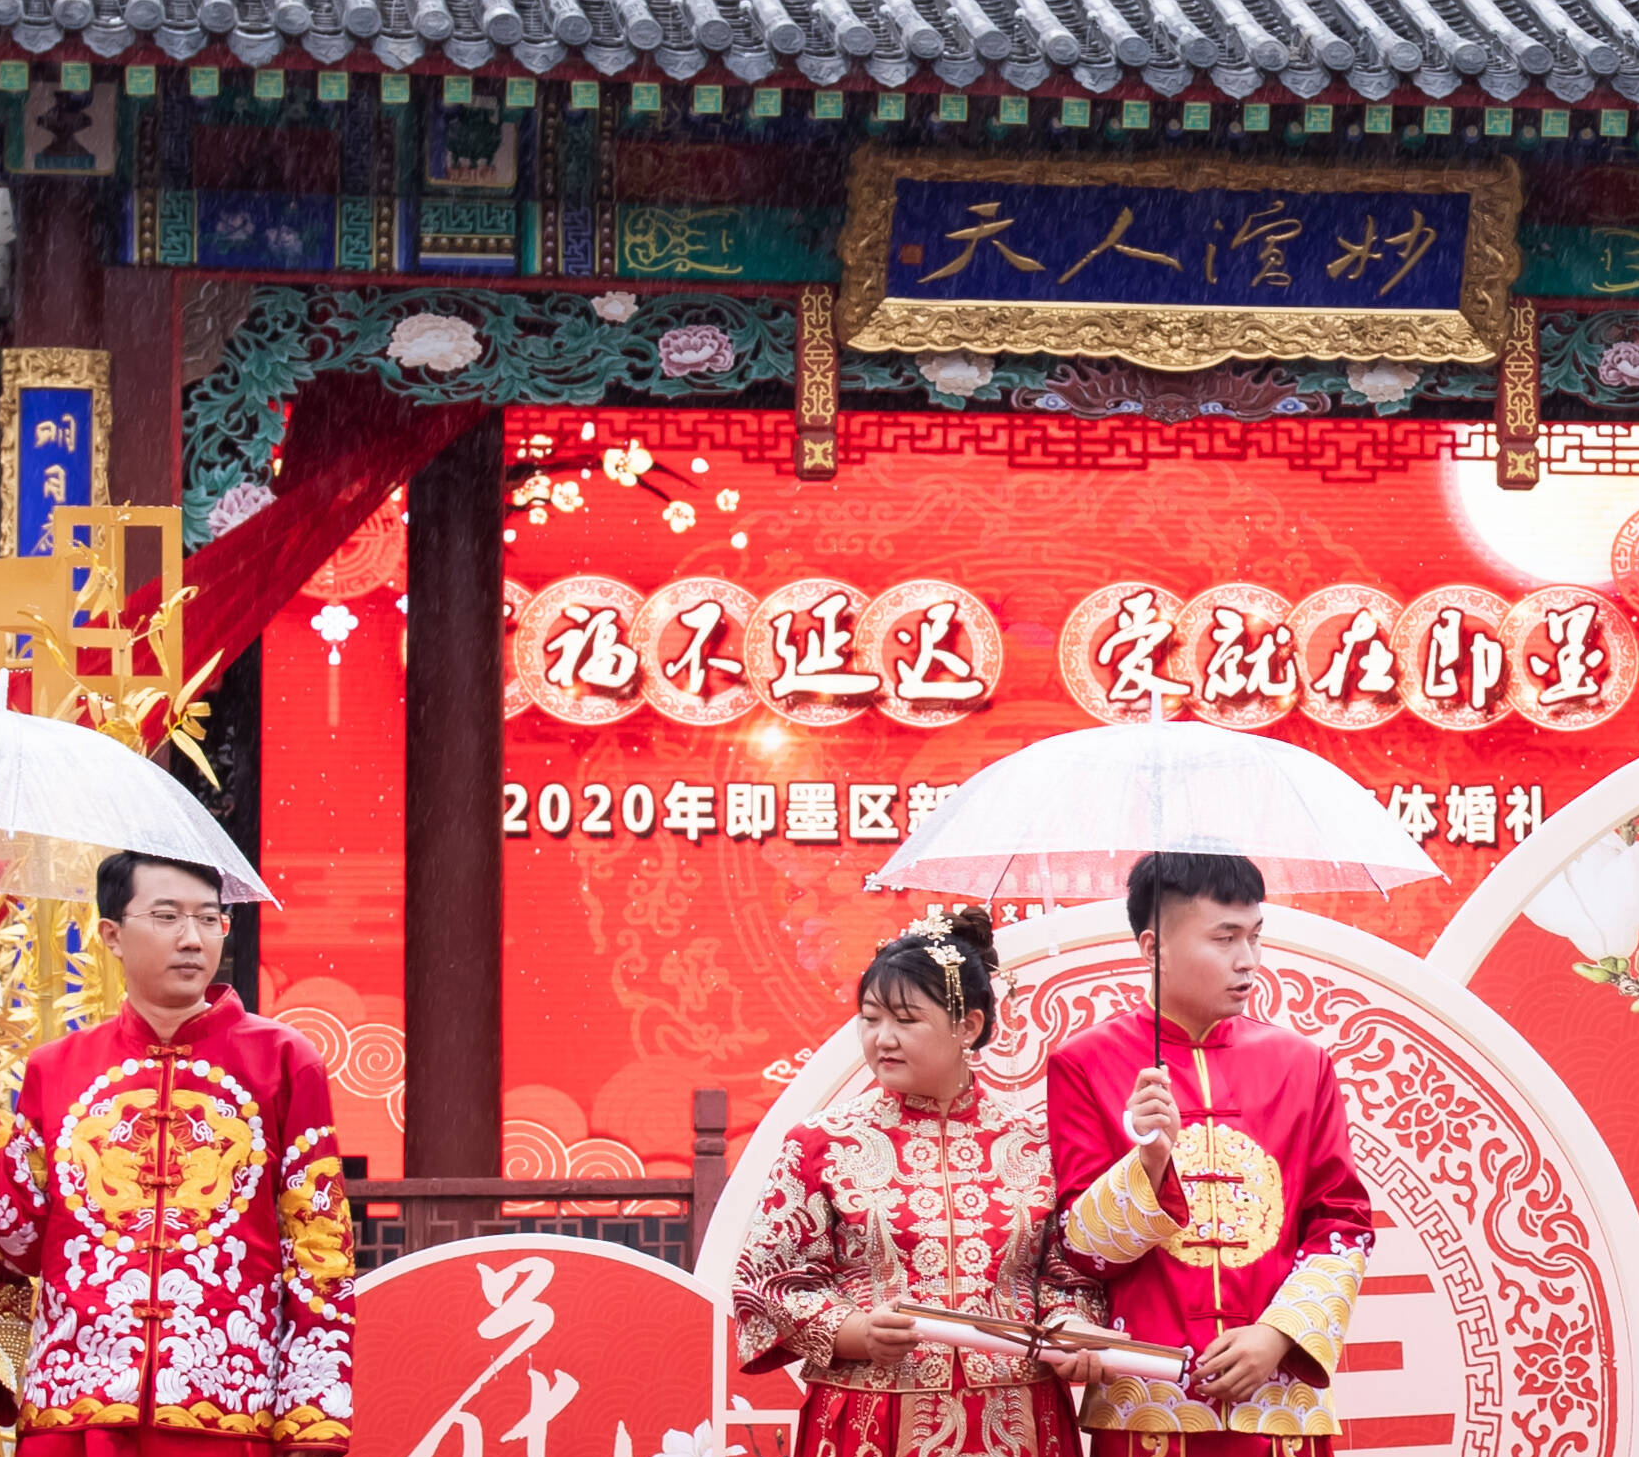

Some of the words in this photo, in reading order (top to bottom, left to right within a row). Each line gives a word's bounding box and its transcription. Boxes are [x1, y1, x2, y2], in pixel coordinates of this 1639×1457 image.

[503, 593, 985, 701] 福不延迟
[1096, 590, 1606, 710] 爱就在即墨
[1366, 784, 1543, 844] 体婚礼
